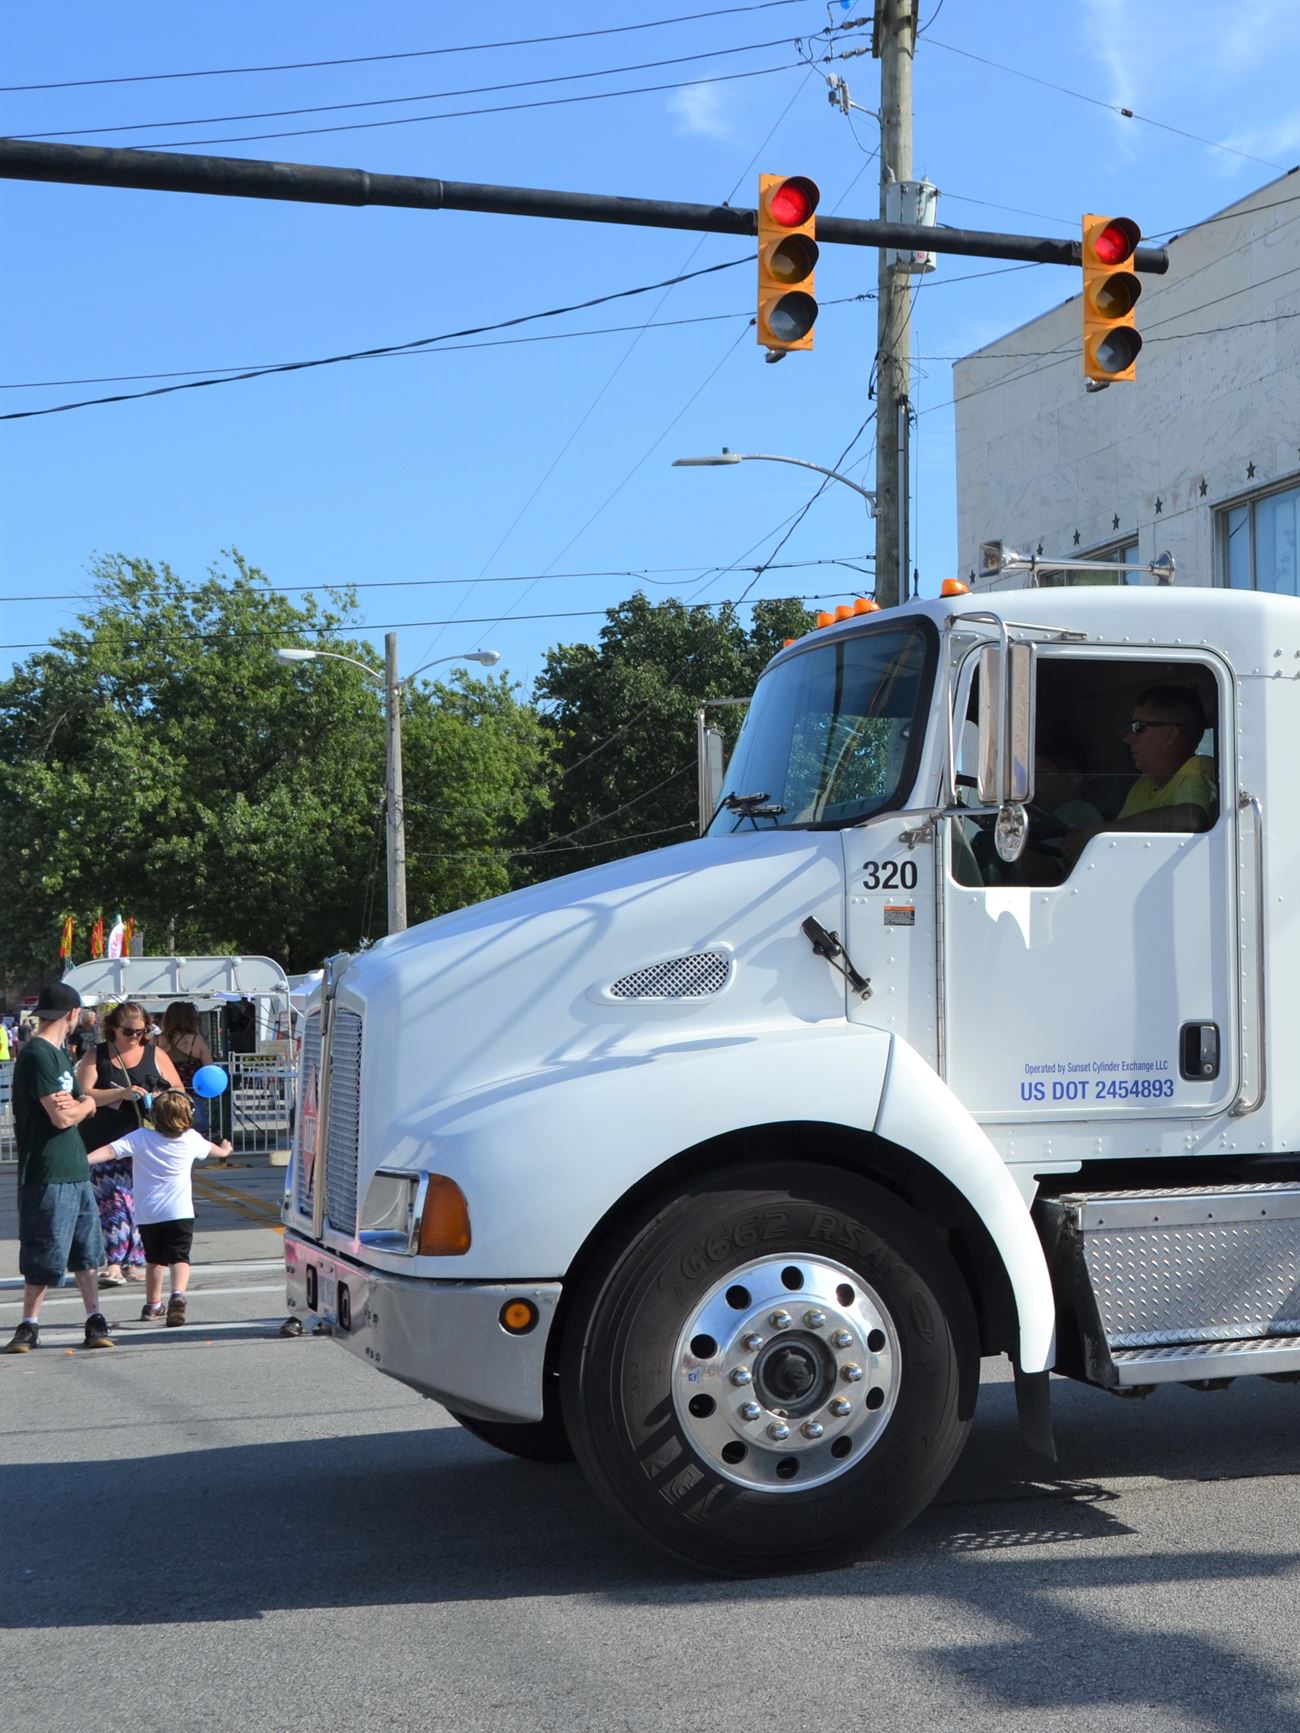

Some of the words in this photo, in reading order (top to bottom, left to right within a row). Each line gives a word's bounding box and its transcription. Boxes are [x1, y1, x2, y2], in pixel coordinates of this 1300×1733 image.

[862, 860, 918, 890] 320
[1025, 1063, 1056, 1075] Operated
[1057, 1063, 1066, 1075] by
[1067, 1062, 1091, 1072] Sunset
[1092, 1061, 1120, 1073] Cylinder
[1121, 1060, 1154, 1072] Exchange
[1155, 1060, 1168, 1070] LLC
[1021, 1081, 1045, 1101] US
[1053, 1080, 1089, 1100] DOT
[1095, 1079, 1174, 1099] 2454893
